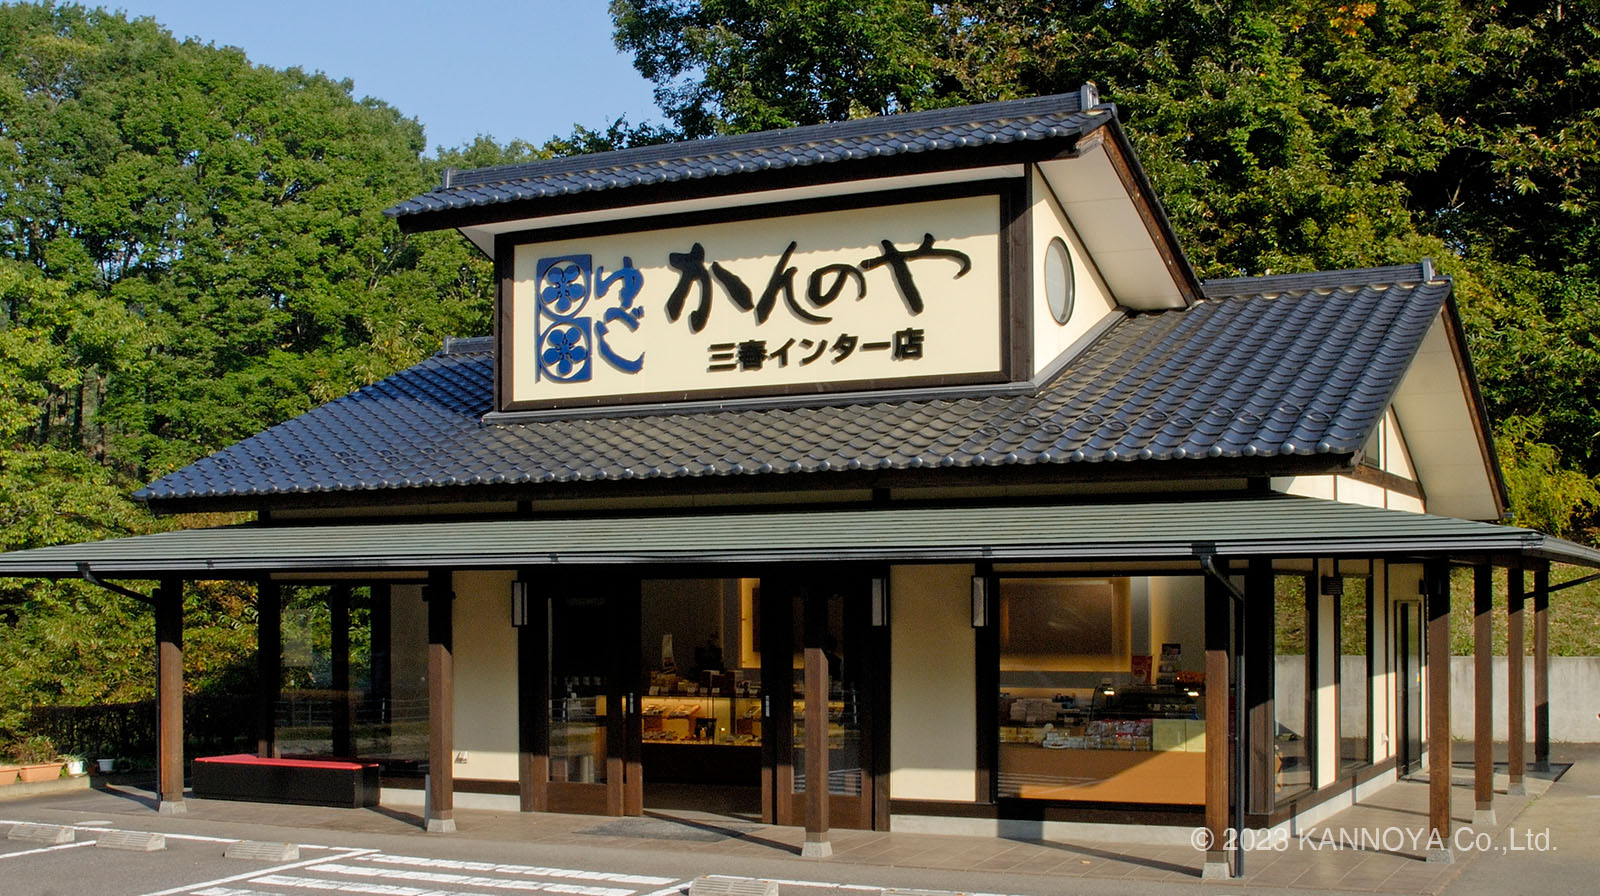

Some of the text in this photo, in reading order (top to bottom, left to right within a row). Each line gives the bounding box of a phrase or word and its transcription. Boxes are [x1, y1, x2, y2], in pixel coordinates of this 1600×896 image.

[665, 232, 972, 333] かんのや
[707, 327, 925, 372] 三春インター店
